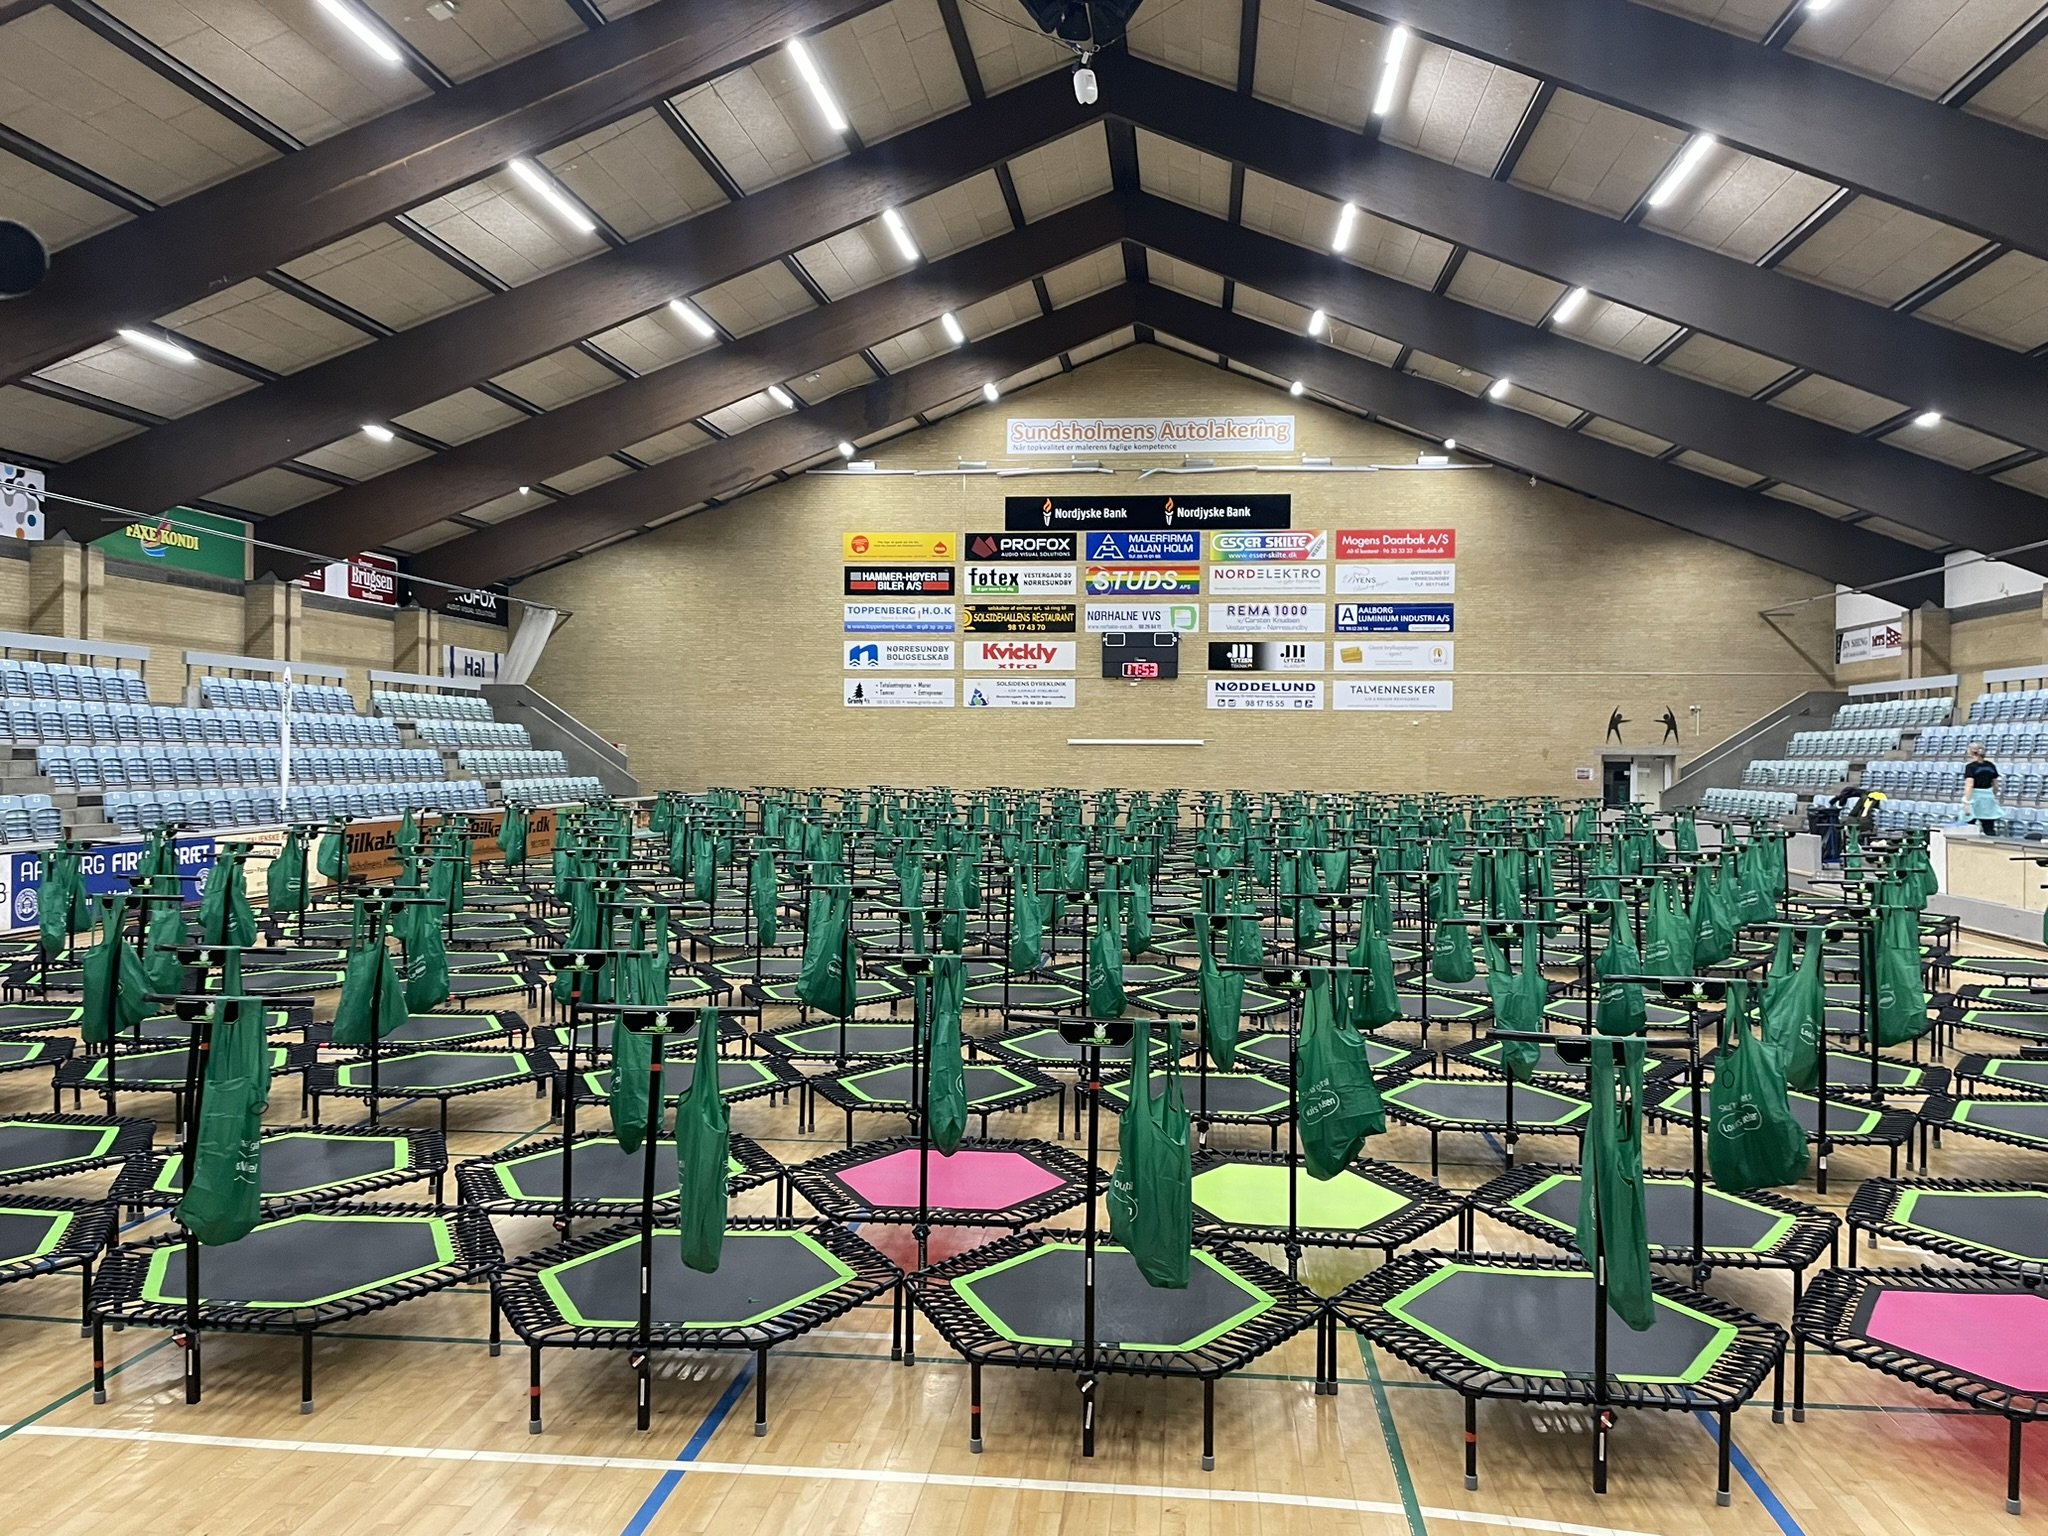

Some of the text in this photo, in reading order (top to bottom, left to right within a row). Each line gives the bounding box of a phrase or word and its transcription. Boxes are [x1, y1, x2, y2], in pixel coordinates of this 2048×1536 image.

[1012, 419, 1290, 443] Sundsholmens Autolakering
[1027, 444, 1064, 452] topkvalitet
[1109, 443, 1132, 452] faglige
[1134, 443, 1177, 452] kompetence
[1055, 508, 1127, 520] Nordjyske Bank
[1177, 507, 1250, 519] Nordjyske Bank
[160, 530, 199, 550] KONDI
[1129, 534, 1193, 543] MALERFIRMA
[1220, 537, 1307, 549] ESSER SKILTE
[1342, 533, 1449, 547] Mogens Daarbak A/S
[1000, 538, 1070, 551] PROFOX
[1128, 544, 1193, 553] ALLAN HOLM
[863, 572, 937, 581] HAMMER-HØYER
[968, 568, 1019, 586] føtex
[1214, 569, 1321, 579] NORDELEKTRO
[1093, 571, 1178, 590] STUDS
[878, 582, 922, 590] BILER A/S
[1087, 611, 1161, 621] NØRHALNE VVS
[1227, 606, 1307, 616] REMA 1000
[973, 613, 1074, 622] SOLSIDEHALLENS RESTAURANT
[1436, 614, 1450, 622] A/S
[982, 643, 1057, 663] Kvickly
[465, 656, 485, 677] Hal
[1215, 682, 1316, 692] NØDDELUND
[1350, 685, 1435, 694] TALMENNESKER
